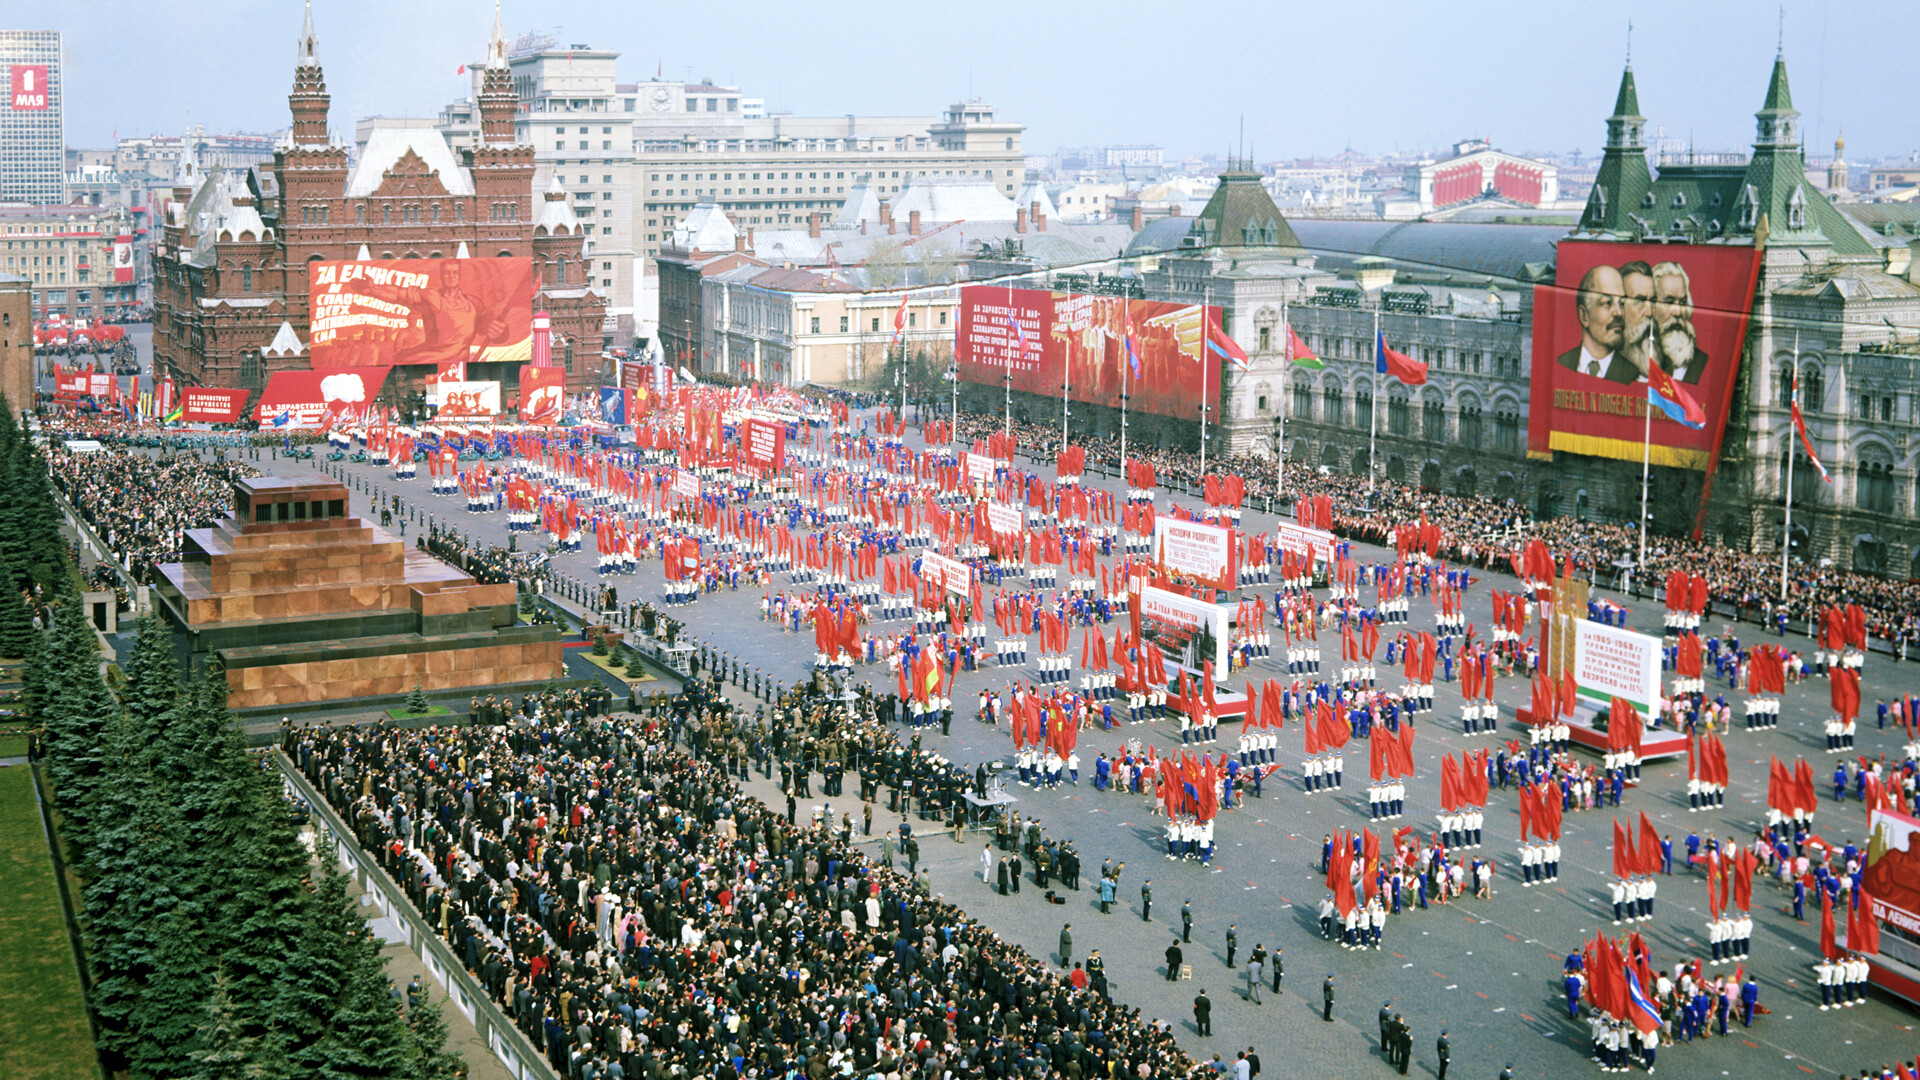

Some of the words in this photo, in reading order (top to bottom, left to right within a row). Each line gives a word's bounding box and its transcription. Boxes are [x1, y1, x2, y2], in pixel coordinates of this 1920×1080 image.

[23, 70, 34, 91] 1
[16, 95, 44, 106] МАЯ
[92, 171, 118, 183] КПСС
[316, 265, 336, 285] ЗА
[328, 283, 342, 293] И
[315, 304, 350, 320] ВСЕХ
[316, 293, 411, 316] СПЛОЧЕННОСТЬ
[973, 304, 981, 313] ДА
[973, 314, 988, 325] ДЕНЬ
[188, 400, 231, 408] СОДРУЖЕСТВО
[276, 402, 329, 410] ЗДРАВСТВУЕТ
[1589, 392, 1597, 412] К
[1599, 392, 1633, 417] ПОБЕДЕ
[1146, 600, 1152, 609] ЗА
[1153, 600, 1158, 611] 3
[1158, 603, 1170, 615] ГОДА
[1171, 607, 1198, 623] ПЯТИЛЕТКИ
[1585, 641, 1641, 661] ПРОИЗВОДСТВО
[1584, 656, 1641, 677] ПРОДУКТОВ
[1582, 670, 1618, 688] ВОЗРОСЛО
